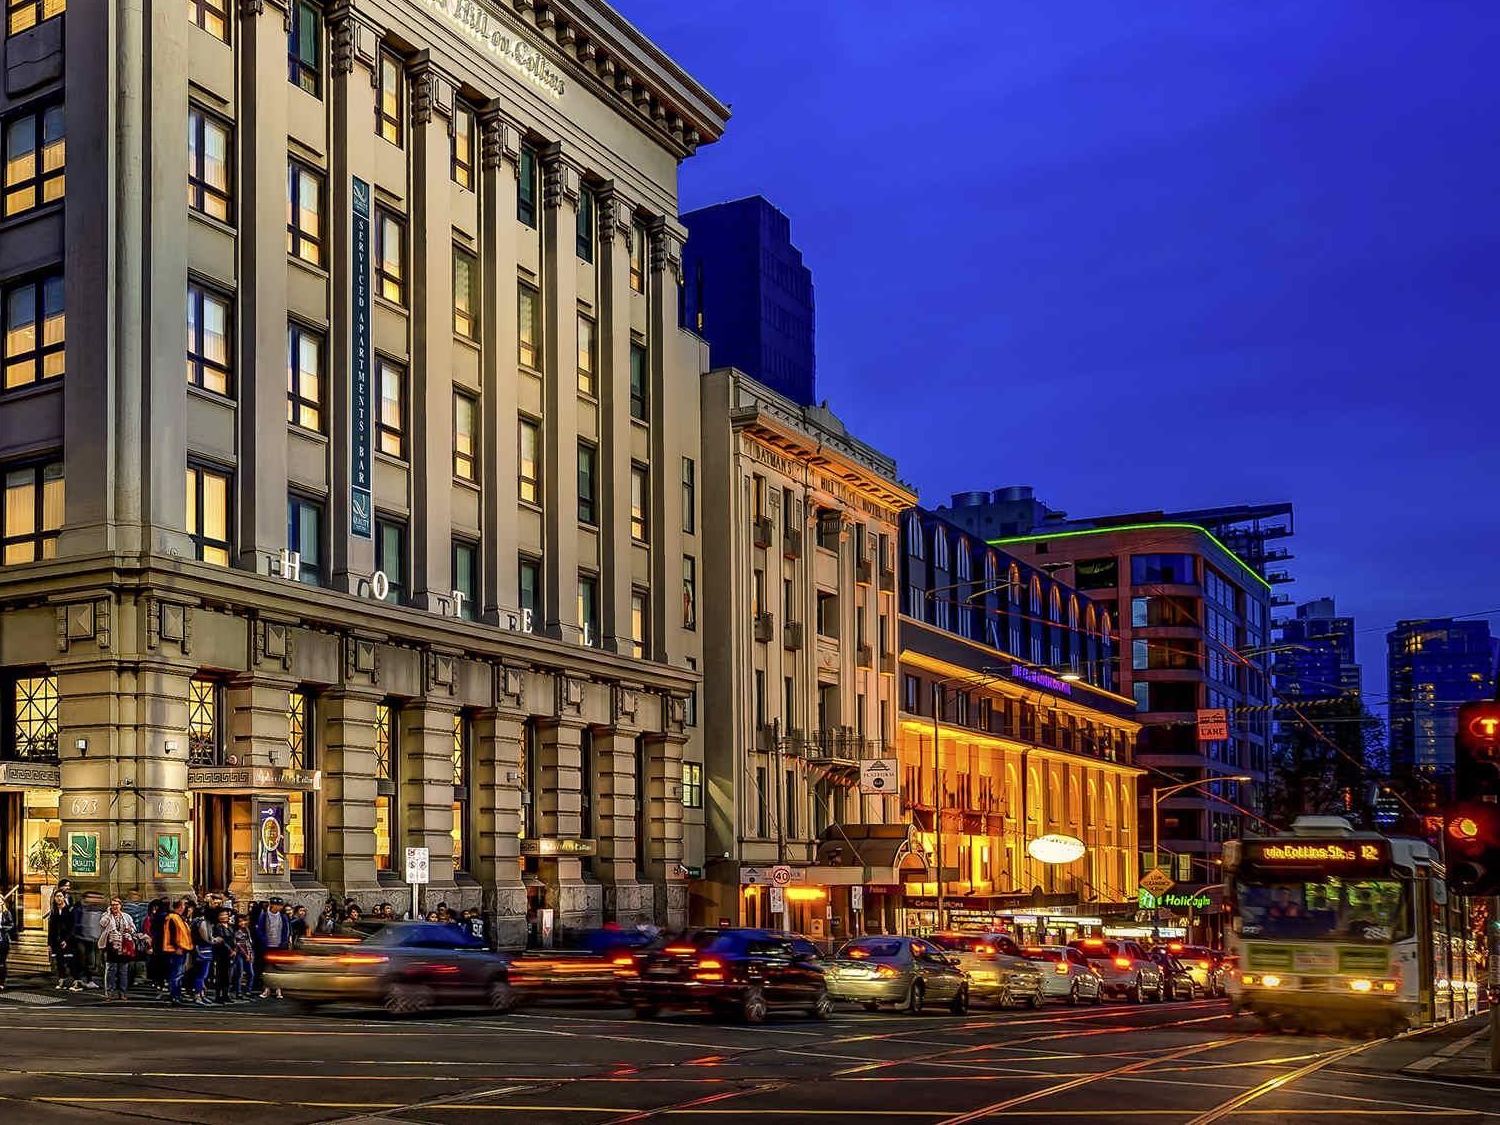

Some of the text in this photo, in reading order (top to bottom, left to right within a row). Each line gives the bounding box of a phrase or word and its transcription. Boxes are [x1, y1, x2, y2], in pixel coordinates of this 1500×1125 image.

[512, 40, 566, 97] Collins
[280, 548, 593, 646] HOTEL
[72, 798, 98, 814] 623
